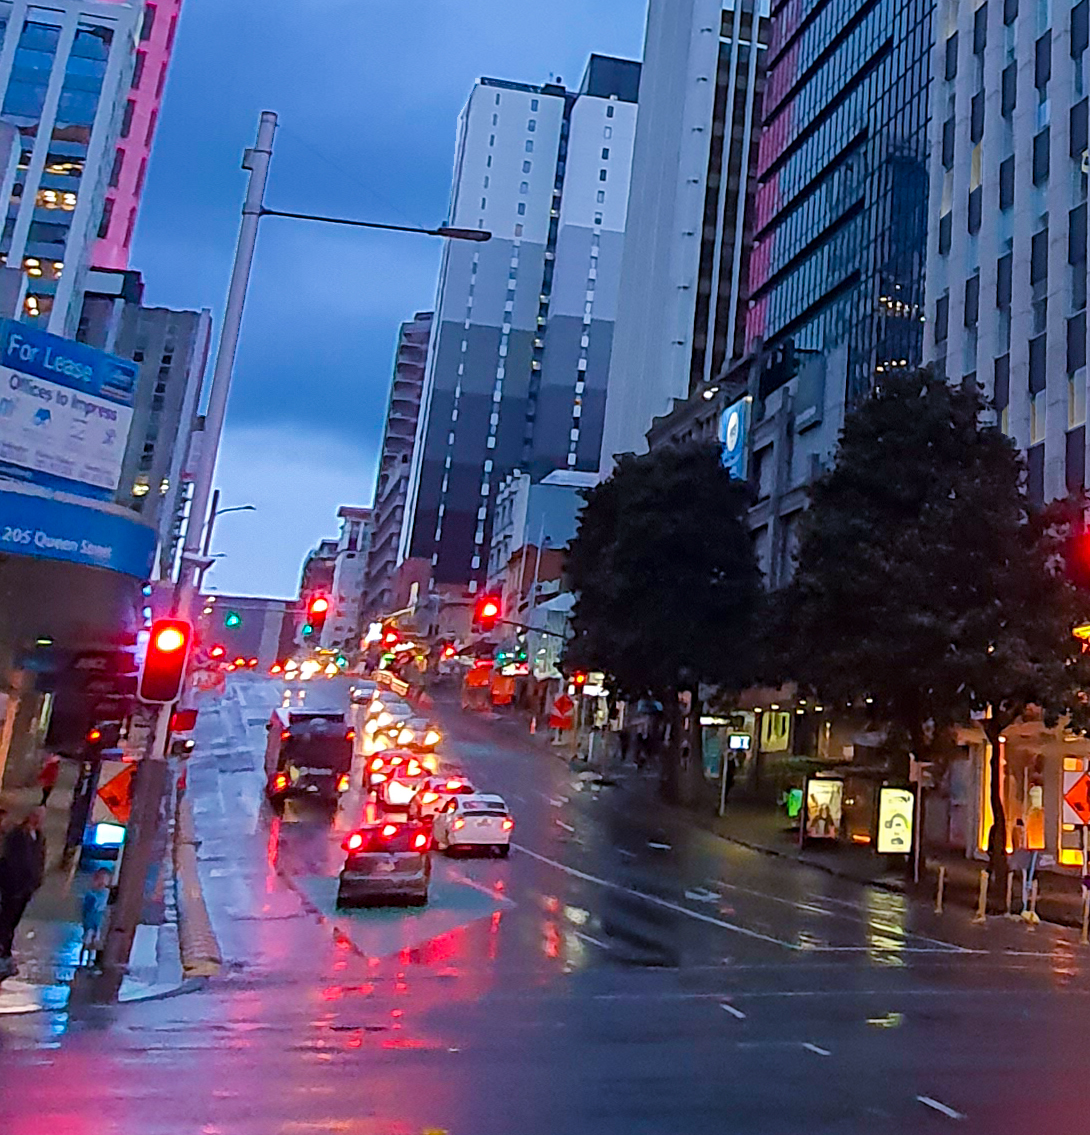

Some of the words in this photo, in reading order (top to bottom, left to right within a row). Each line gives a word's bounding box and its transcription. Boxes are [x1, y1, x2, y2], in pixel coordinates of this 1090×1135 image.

[7, 333, 40, 363] For
[43, 347, 93, 383] Lease
[9, 374, 53, 403] Offices
[56, 390, 69, 406] to
[2, 526, 33, 544] 205
